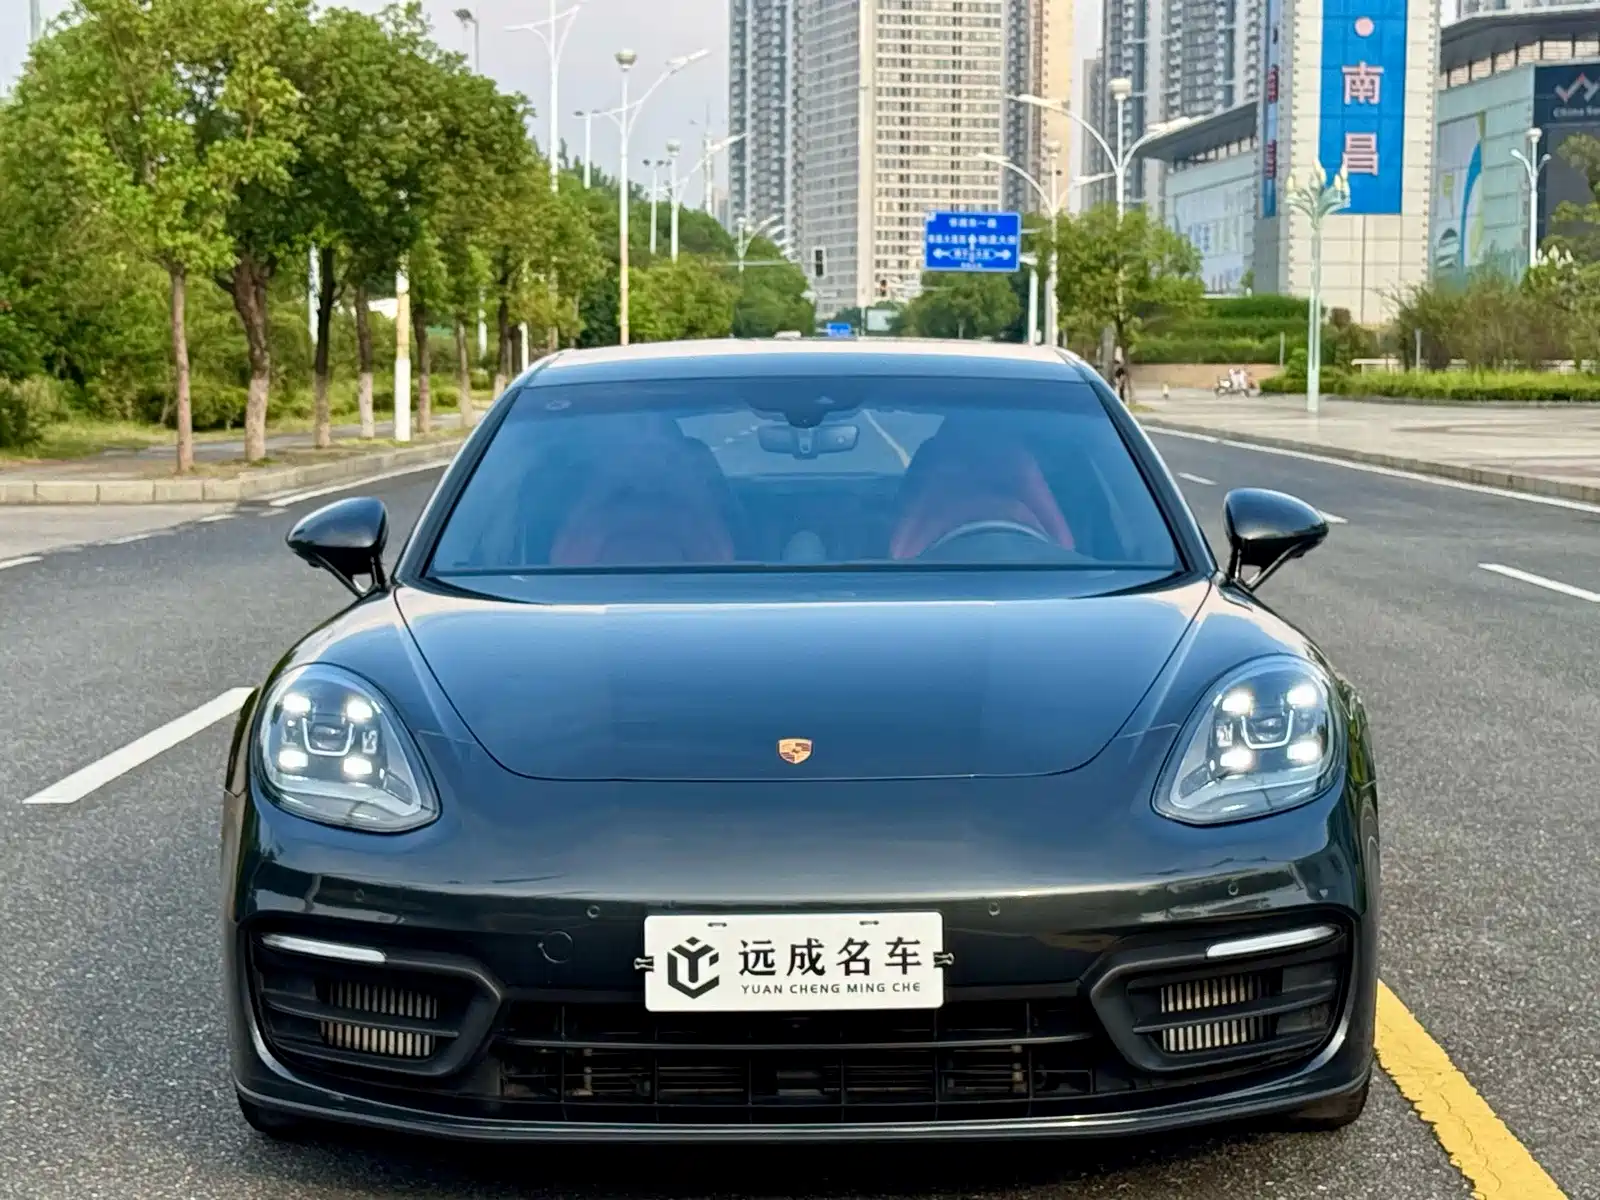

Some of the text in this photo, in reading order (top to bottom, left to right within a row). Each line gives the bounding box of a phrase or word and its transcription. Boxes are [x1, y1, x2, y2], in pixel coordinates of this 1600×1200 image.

[1342, 61, 1384, 176] 南昌
[739, 937, 922, 976] 远成名车
[741, 982, 920, 995] YUAN CHENG MING CHE
